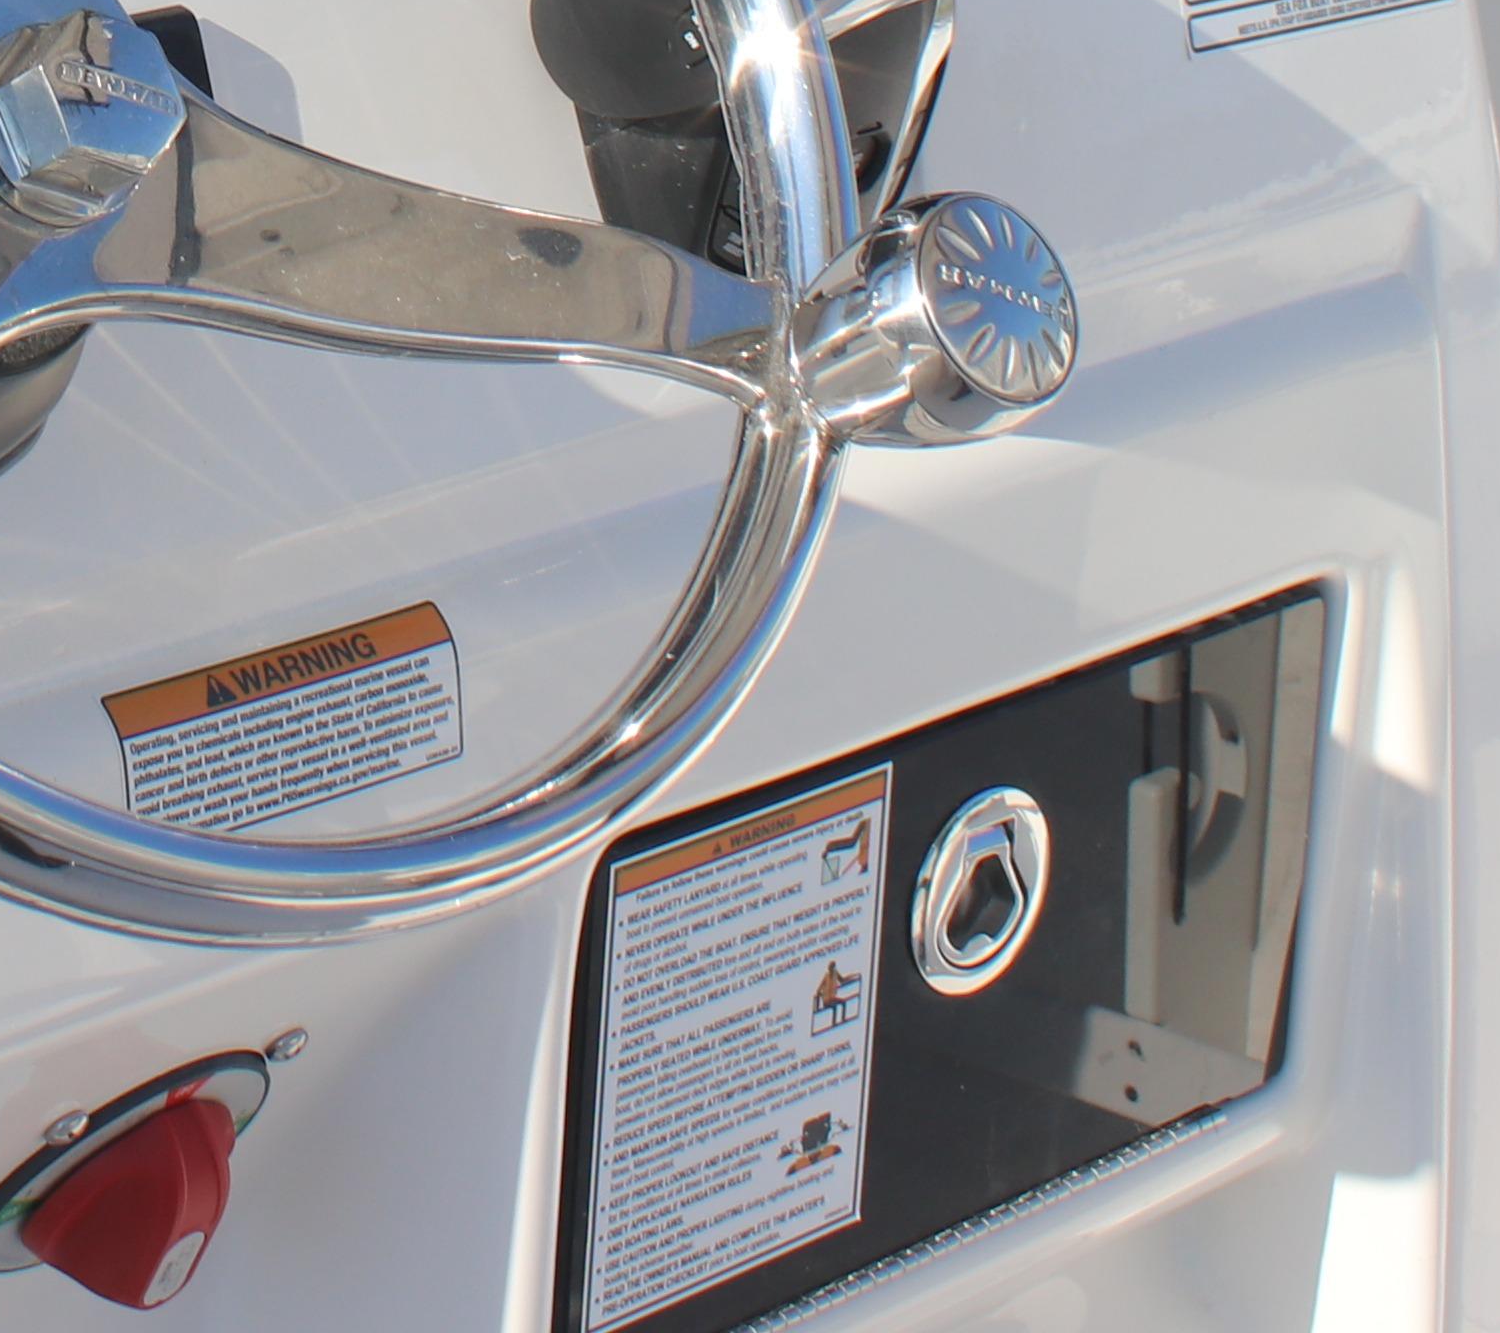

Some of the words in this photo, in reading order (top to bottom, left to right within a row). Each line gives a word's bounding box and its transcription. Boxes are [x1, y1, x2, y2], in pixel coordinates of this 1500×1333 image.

[130, 733, 176, 756] Operating,
[178, 720, 219, 739] servicing
[221, 712, 237, 726] and
[239, 698, 292, 721] maintaining
[294, 695, 299, 704] a
[301, 677, 351, 702] recreational
[354, 670, 383, 686] marine
[385, 659, 411, 677] vessel
[413, 656, 429, 668] can
[231, 632, 376, 695] WARNING
[132, 753, 164, 770] expose
[166, 747, 182, 763] you
[185, 743, 193, 754] to
[196, 729, 240, 750] chemicals
[243, 716, 283, 736] including
[285, 707, 313, 723] engine
[354, 685, 383, 702] carbon
[134, 763, 183, 788] phthalates,
[186, 754, 202, 769] and
[228, 738, 254, 756] which
[256, 735, 270, 747] are
[273, 726, 302, 742] known
[304, 721, 312, 732] to
[315, 716, 329, 729] the
[331, 709, 353, 724] State
[355, 704, 364, 716] of
[365, 693, 405, 713] California
[407, 690, 416, 700] to
[418, 682, 442, 697] cause
[135, 785, 164, 801] cancer
[167, 776, 184, 791] and
[186, 769, 206, 785] birth
[209, 760, 242, 778] defects
[244, 757, 252, 767] or
[256, 750, 277, 764] other
[281, 732, 334, 756] reproductive
[363, 719, 372, 730] To
[375, 708, 412, 727] minimize
[162, 788, 204, 808] breathing
[246, 765, 277, 782] service
[280, 758, 297, 774] your
[301, 746, 328, 764] vessel
[330, 744, 338, 755] in
[341, 743, 345, 752] a
[412, 716, 431, 729] area
[433, 709, 448, 723] and
[192, 804, 201, 814] or
[204, 793, 227, 810] wash
[230, 789, 247, 806] your
[251, 779, 276, 795] hands
[280, 764, 323, 786] frequently
[326, 757, 349, 772] when
[351, 745, 389, 764] servicing
[391, 738, 407, 751] this
[232, 807, 242, 821] go
[245, 803, 253, 813] to
[728, 813, 796, 851] WARNING
